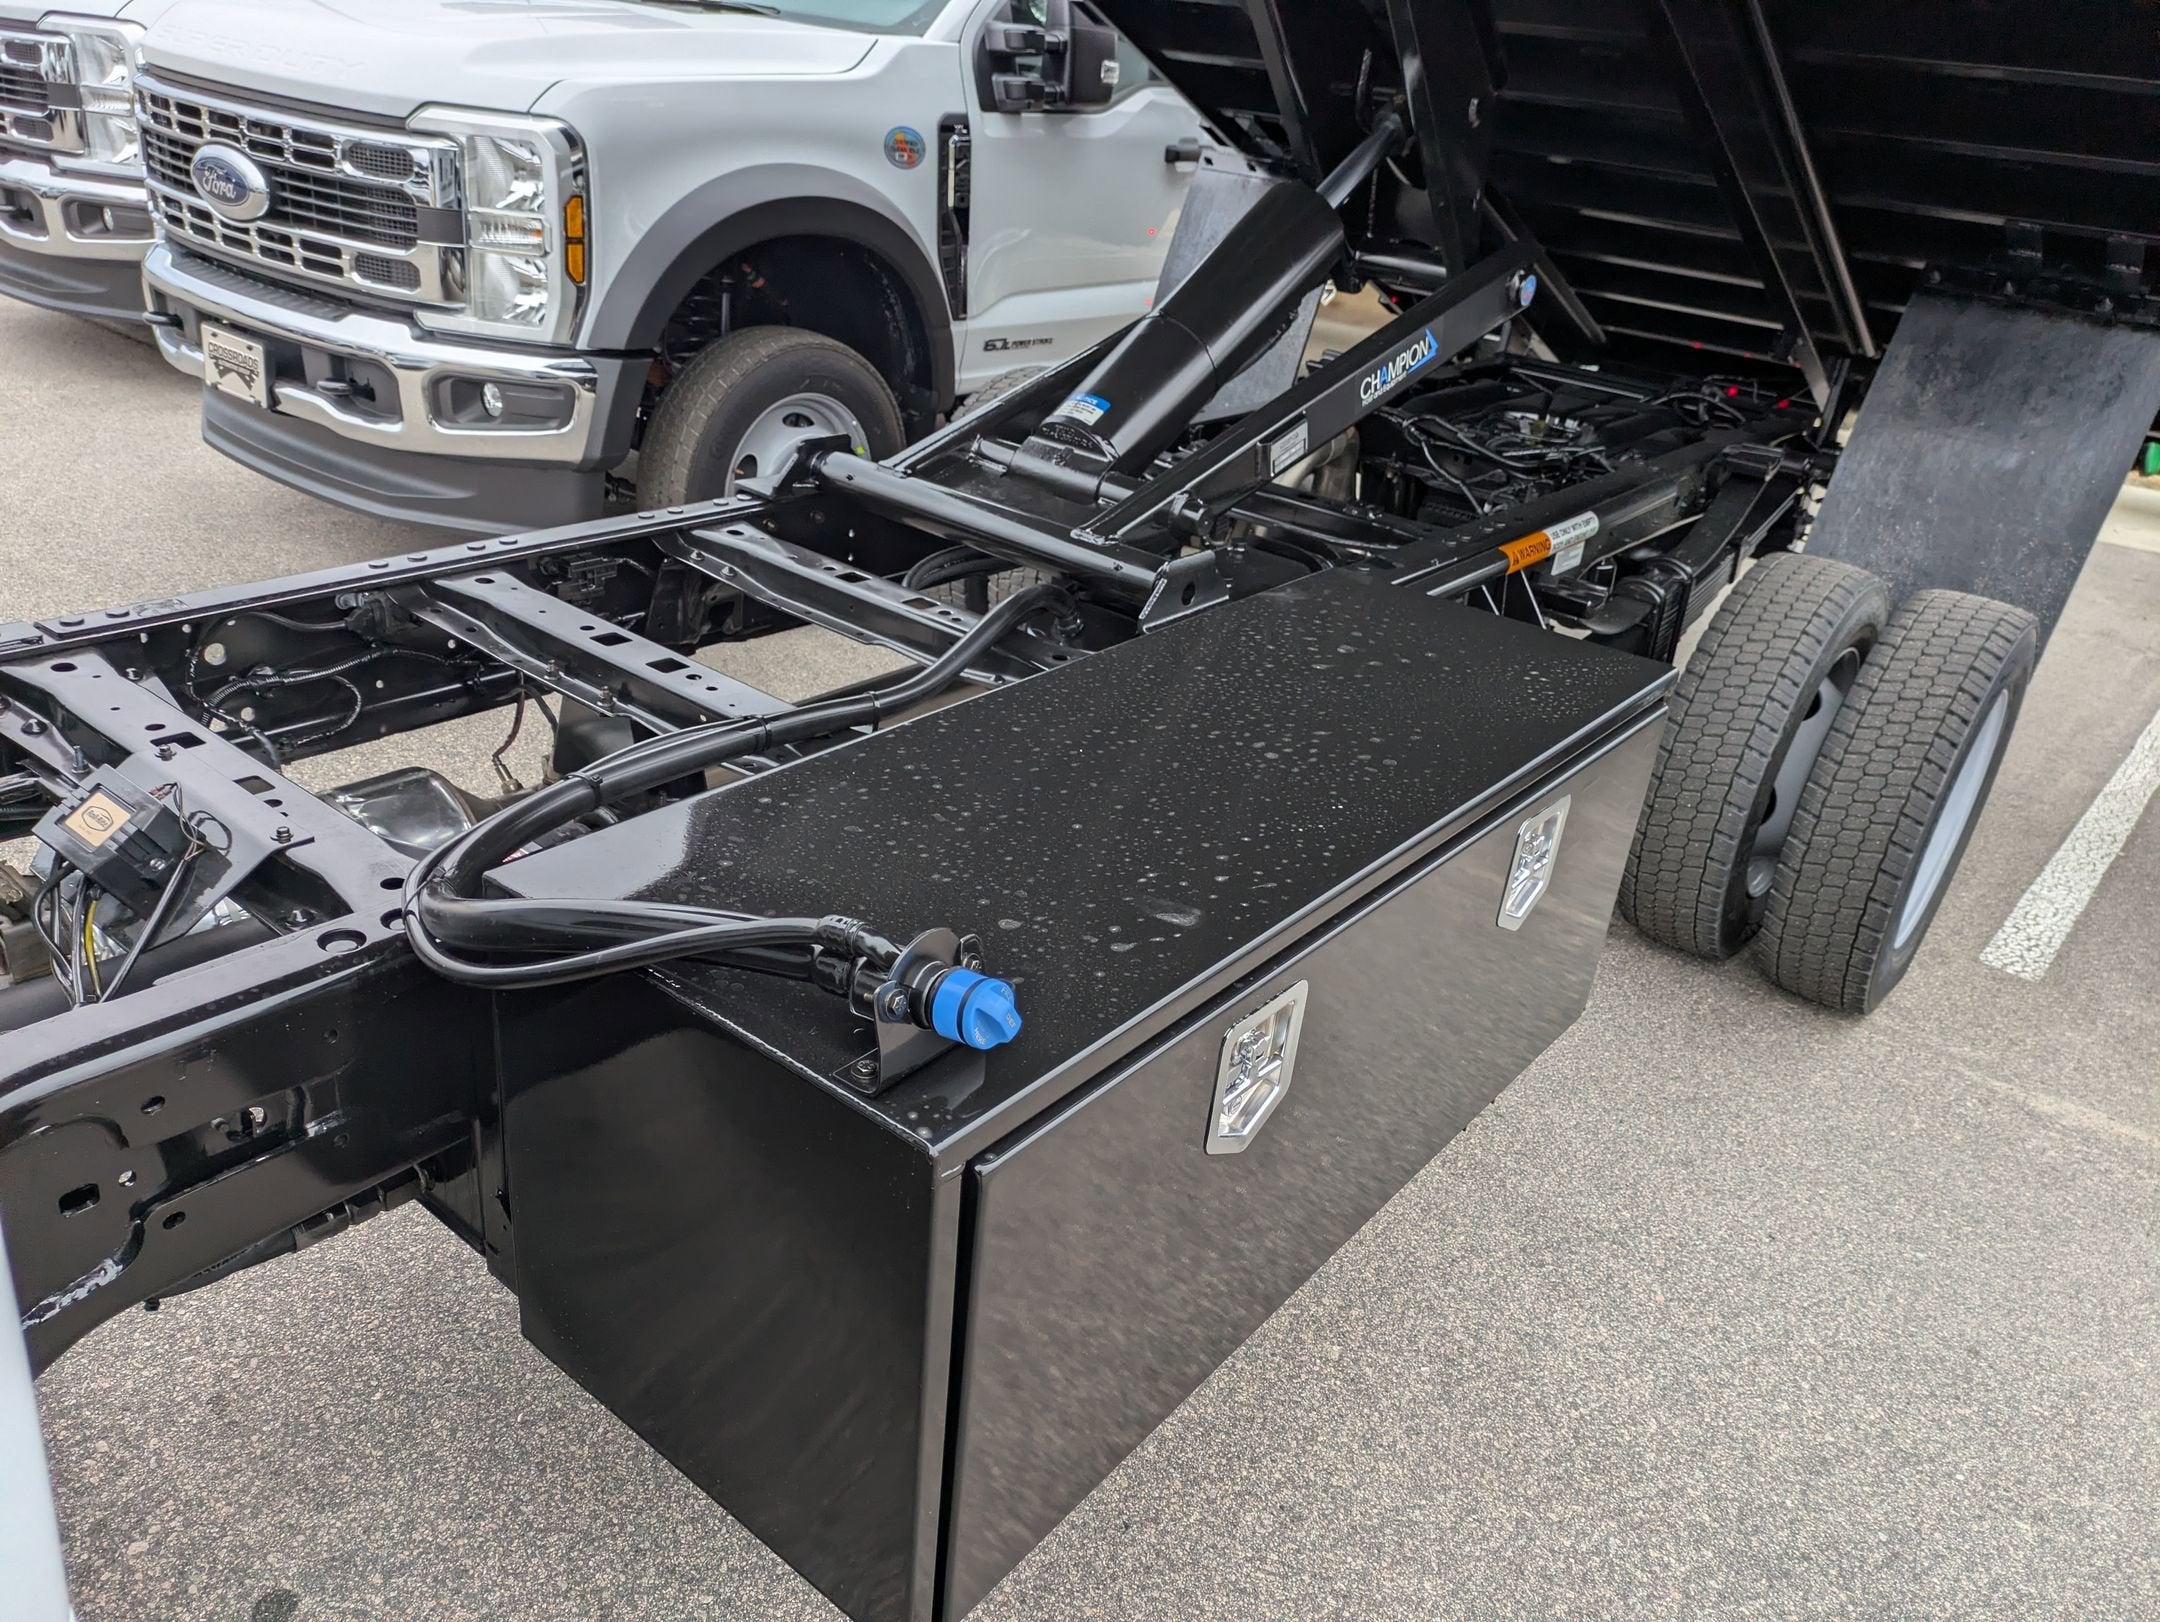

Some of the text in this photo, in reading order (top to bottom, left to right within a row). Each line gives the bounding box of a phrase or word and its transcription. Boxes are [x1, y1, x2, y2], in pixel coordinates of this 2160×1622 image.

[202, 166, 237, 199] Ford
[208, 341, 260, 370] CROSSROADS
[1360, 336, 1429, 400] CHAMPION
[1520, 539, 1551, 558] WARNING
